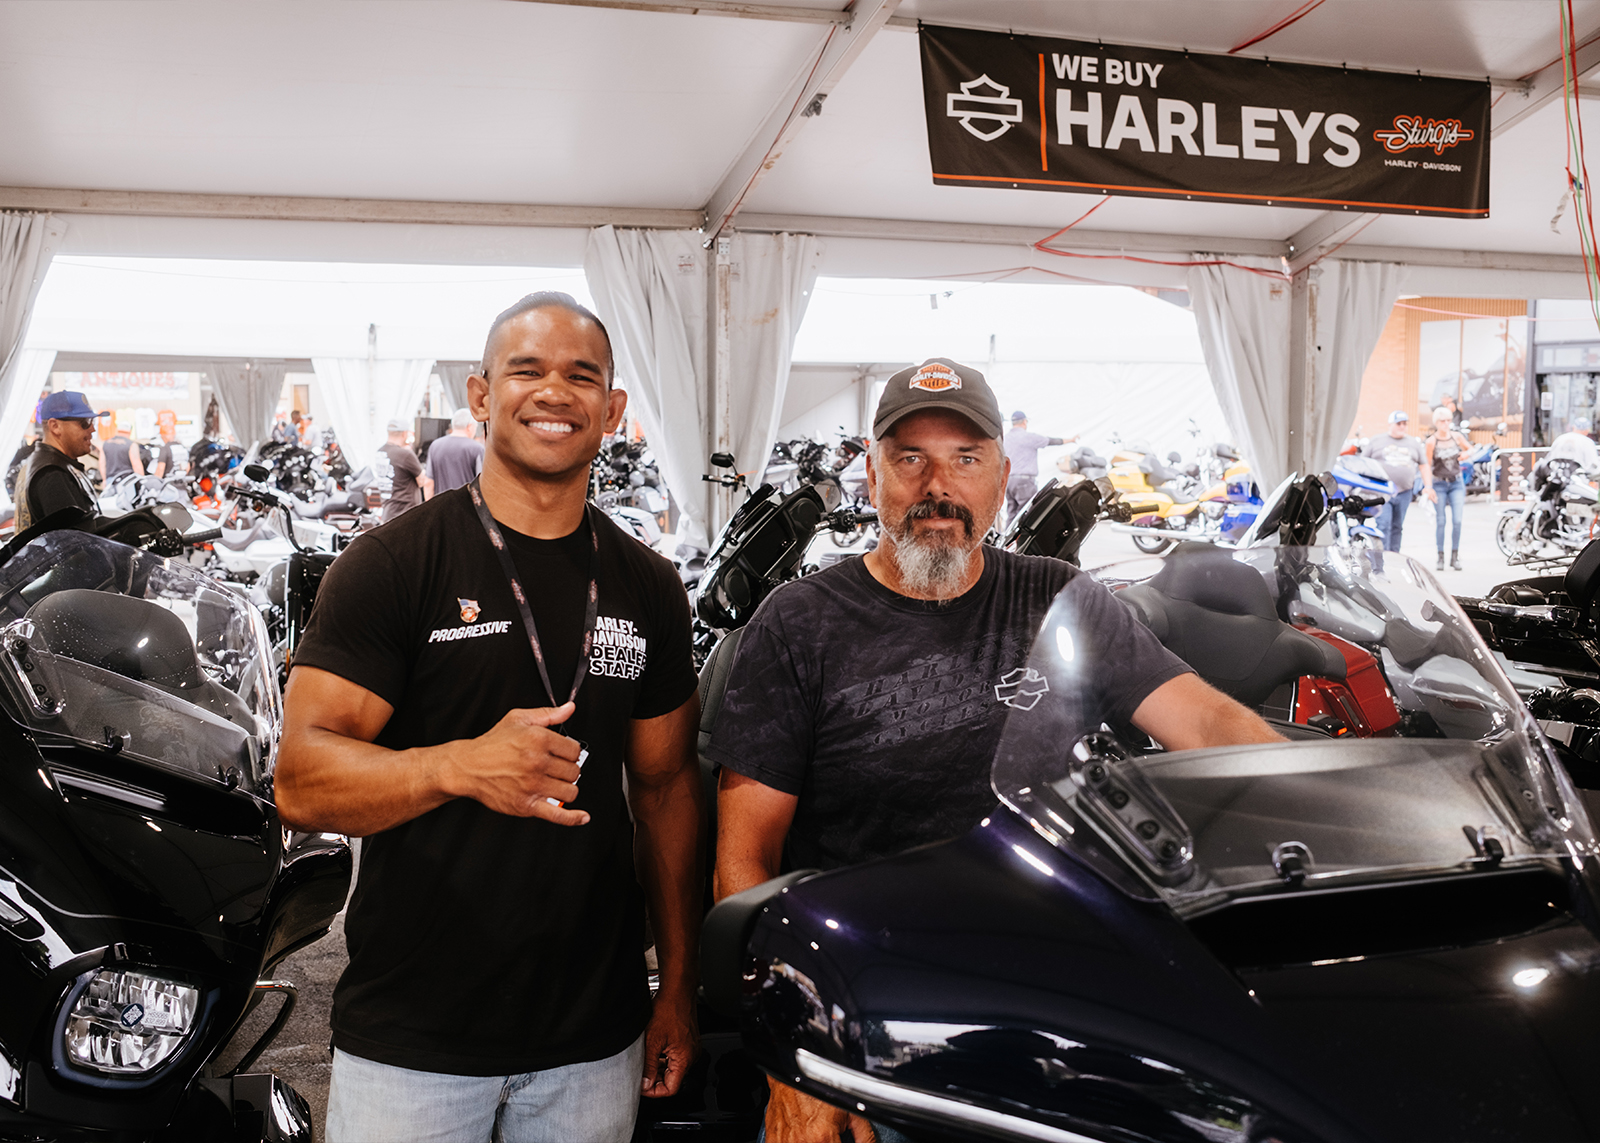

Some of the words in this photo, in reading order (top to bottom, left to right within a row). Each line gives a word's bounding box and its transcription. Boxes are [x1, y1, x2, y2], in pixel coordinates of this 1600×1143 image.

[1052, 53, 1099, 83] WE
[1105, 58, 1164, 89] BUY
[1055, 88, 1361, 168] HARLEYS
[1377, 118, 1471, 152] Sturgis
[80, 371, 175, 388] ANTIQUES
[428, 620, 509, 643] PROGRESSIVE
[595, 616, 639, 635] ARLEY-
[589, 659, 641, 681] STAFF
